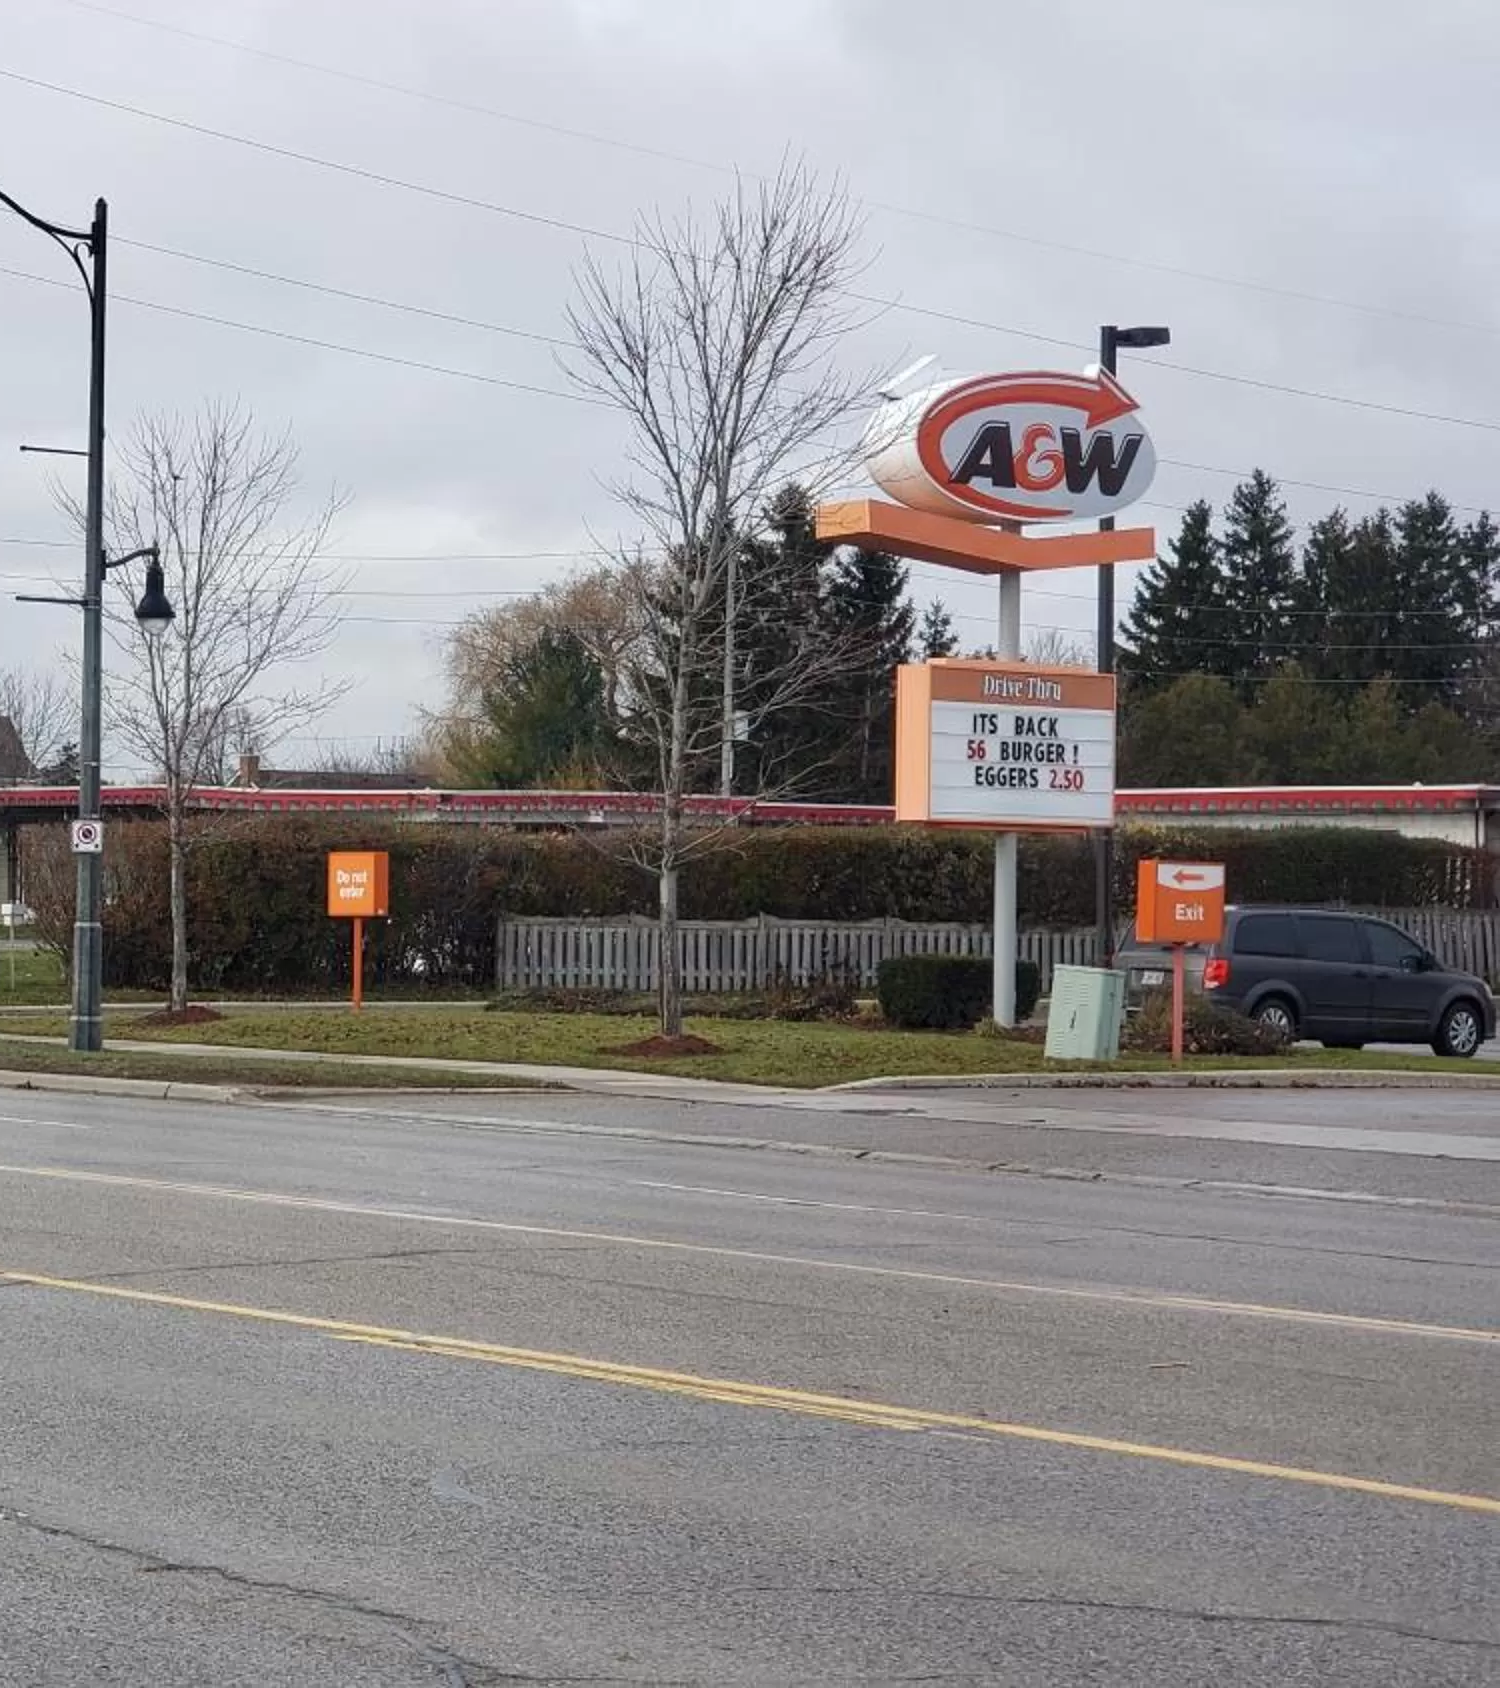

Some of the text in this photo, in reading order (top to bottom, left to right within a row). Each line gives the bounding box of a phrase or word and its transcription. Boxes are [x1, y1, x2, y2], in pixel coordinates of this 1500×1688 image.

[949, 420, 1144, 497] A&W
[984, 675, 1061, 700] Drive Thru
[973, 713, 1058, 737] ITS BACK
[967, 739, 986, 759] 56
[1001, 741, 1065, 763] BURGER
[975, 766, 1084, 790] EGGERS 2.50
[336, 870, 350, 884] Do
[1175, 903, 1204, 921] Exit
